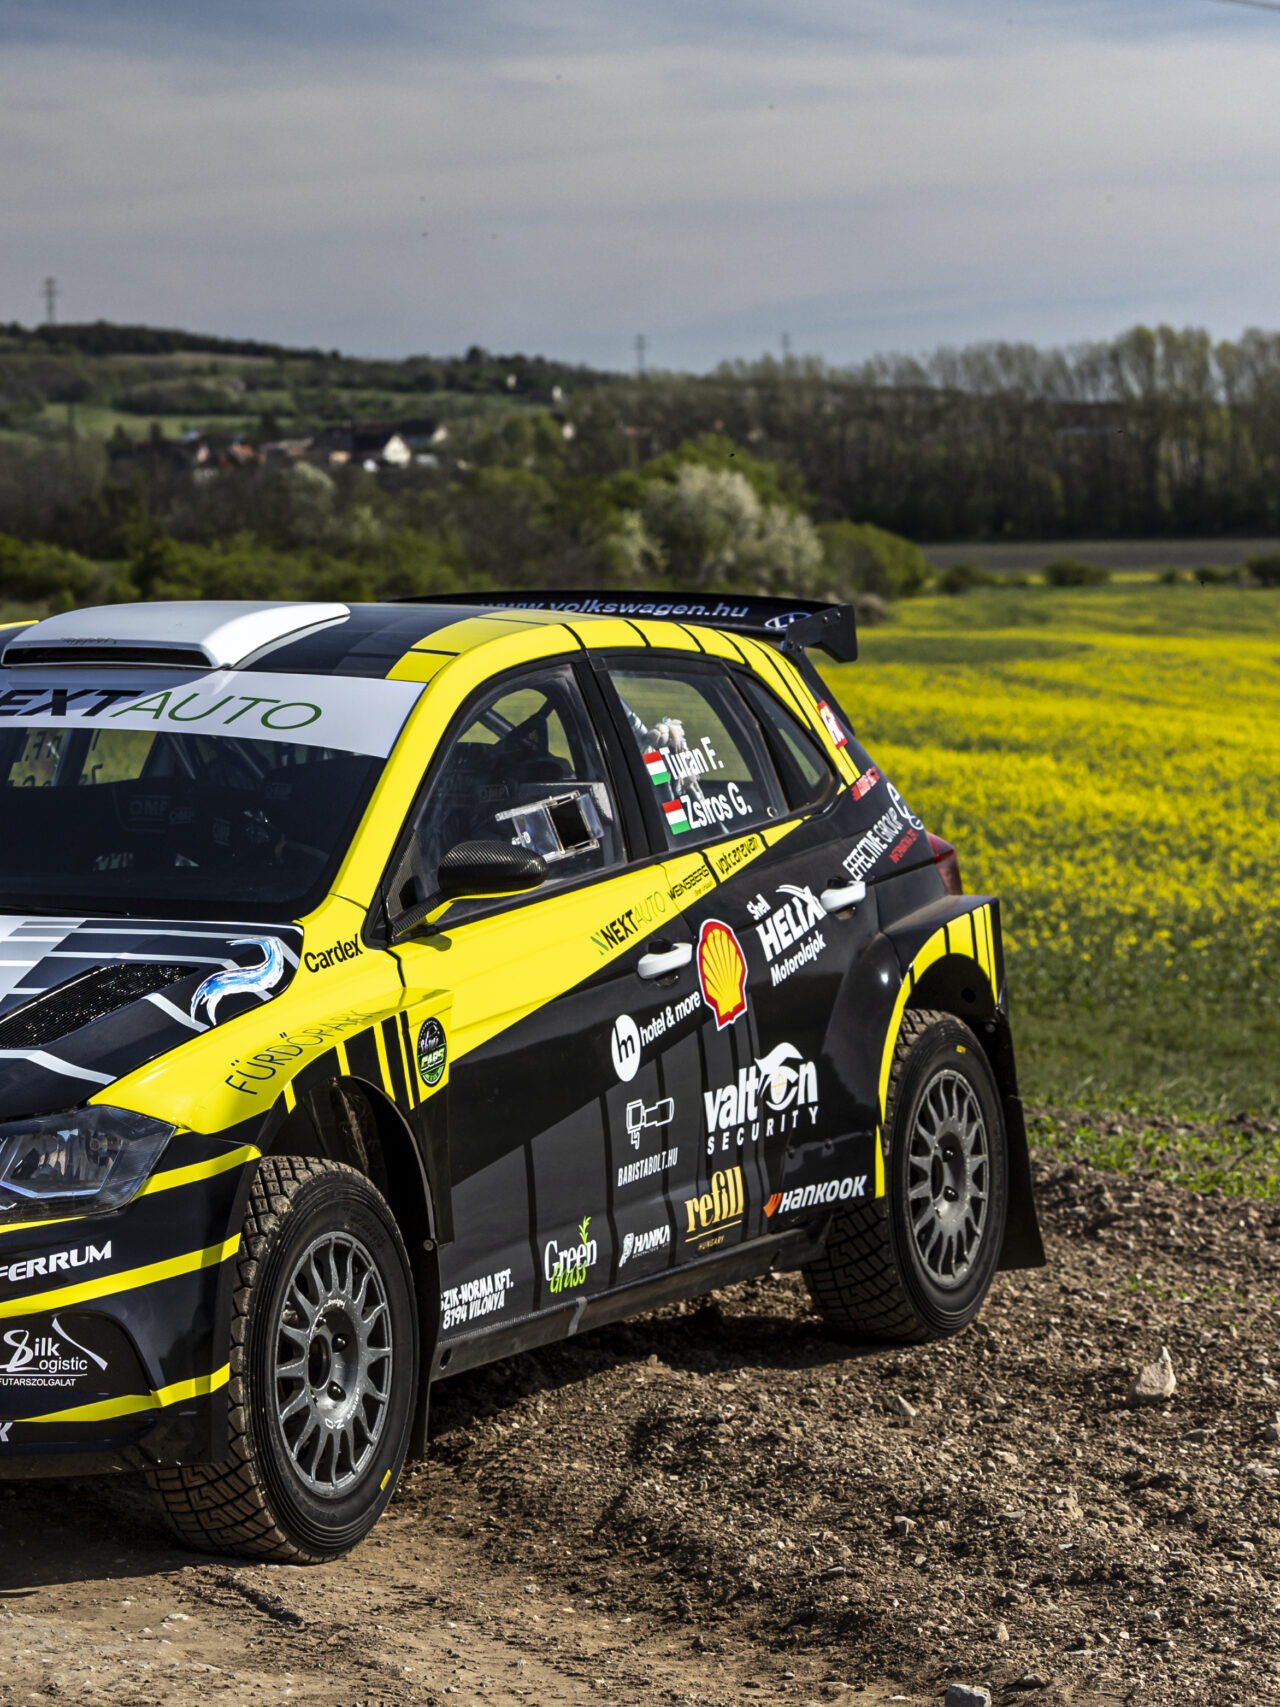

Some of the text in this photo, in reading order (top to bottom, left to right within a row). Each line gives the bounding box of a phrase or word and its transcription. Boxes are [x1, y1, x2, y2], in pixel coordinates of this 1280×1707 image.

[480, 599, 749, 617] wvolkswagen.hu
[700, 736, 725, 770] F.
[727, 782, 753, 815] G.
[842, 830, 888, 881] EFFECTIVE
[873, 807, 904, 845] GROUP
[746, 893, 772, 920] Shell
[755, 885, 828, 962] HELIX
[303, 933, 363, 973] Cardex
[770, 930, 827, 987] Motorolajok
[640, 990, 701, 1047] hotel & more
[707, 1106, 819, 1155] SECURITY
[617, 1147, 679, 1187] BARISTABOLT.HU
[684, 1165, 744, 1233] refill
[633, 1225, 670, 1251] HANKA
[544, 1239, 598, 1281] Green
[549, 1260, 587, 1293] Grass
[493, 1268, 515, 1293] KFT.
[442, 1289, 506, 1330] 8194 VILONYA
[3, 1329, 60, 1366] Silk
[20, 1356, 88, 1374] Logistic
